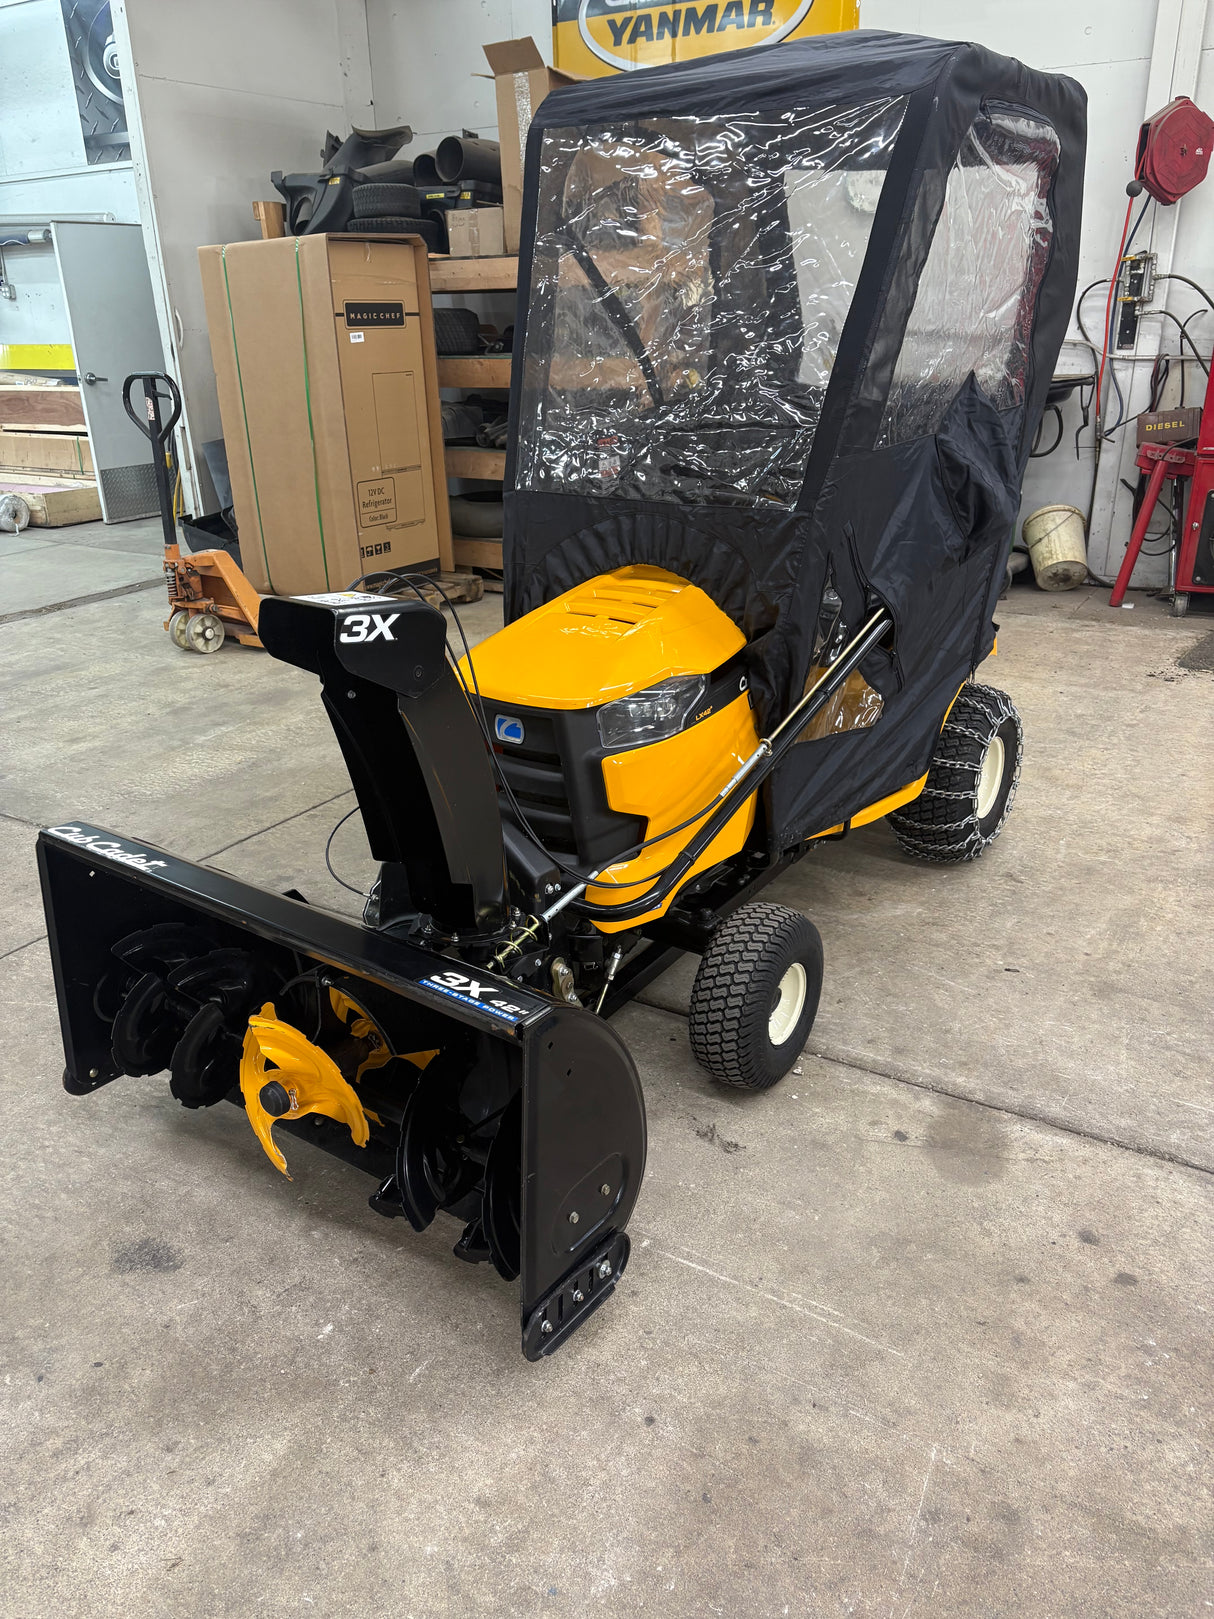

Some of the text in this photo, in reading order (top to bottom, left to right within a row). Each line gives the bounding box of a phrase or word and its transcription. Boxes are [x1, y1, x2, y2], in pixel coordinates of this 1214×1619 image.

[606, 0, 775, 47] YANMAR
[1145, 420, 1184, 431] DIESEL
[362, 498, 392, 509] Refrigerator
[368, 487, 385, 497] 12V DC
[340, 613, 400, 643] 3X
[47, 826, 168, 872] Cub Cadet
[421, 980, 516, 1021] THREE-STAGE POWER
[430, 971, 529, 1015] 3X 42"
